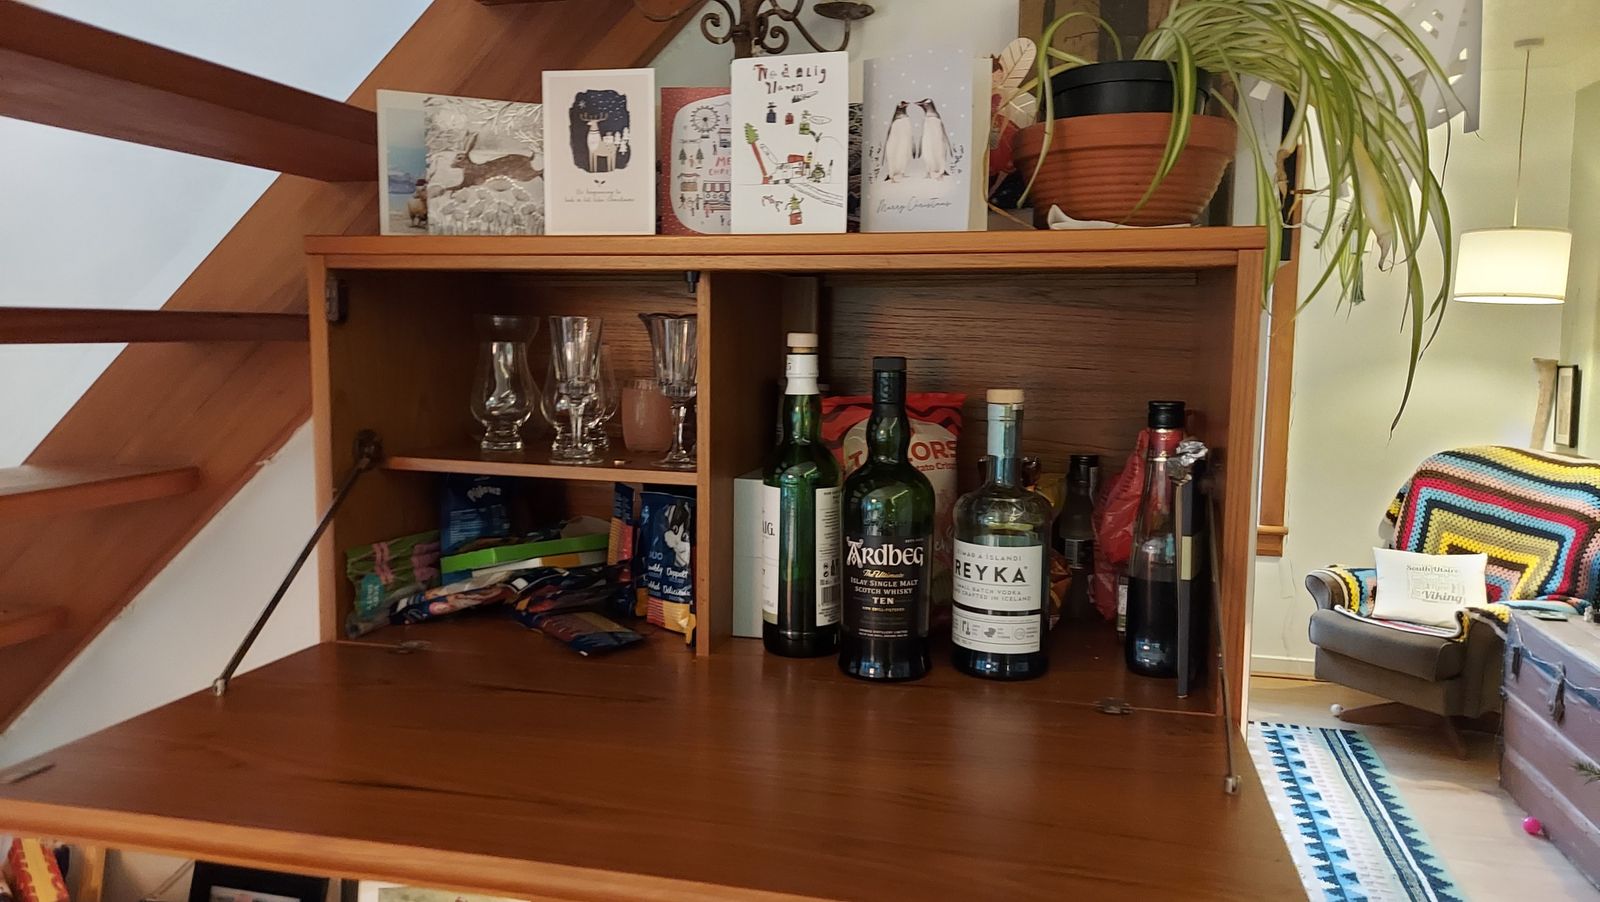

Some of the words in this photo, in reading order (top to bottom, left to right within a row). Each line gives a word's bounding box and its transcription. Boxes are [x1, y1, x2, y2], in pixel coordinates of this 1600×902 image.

[954, 558, 1026, 583] REYKA
[1406, 564, 1431, 573] South
[850, 576, 868, 586] ISLAY
[869, 579, 898, 588] SINGLE
[899, 579, 919, 587] MALT
[854, 586, 882, 595] SCOTCH
[872, 596, 895, 605] TEN
[1422, 590, 1463, 604] Viking
